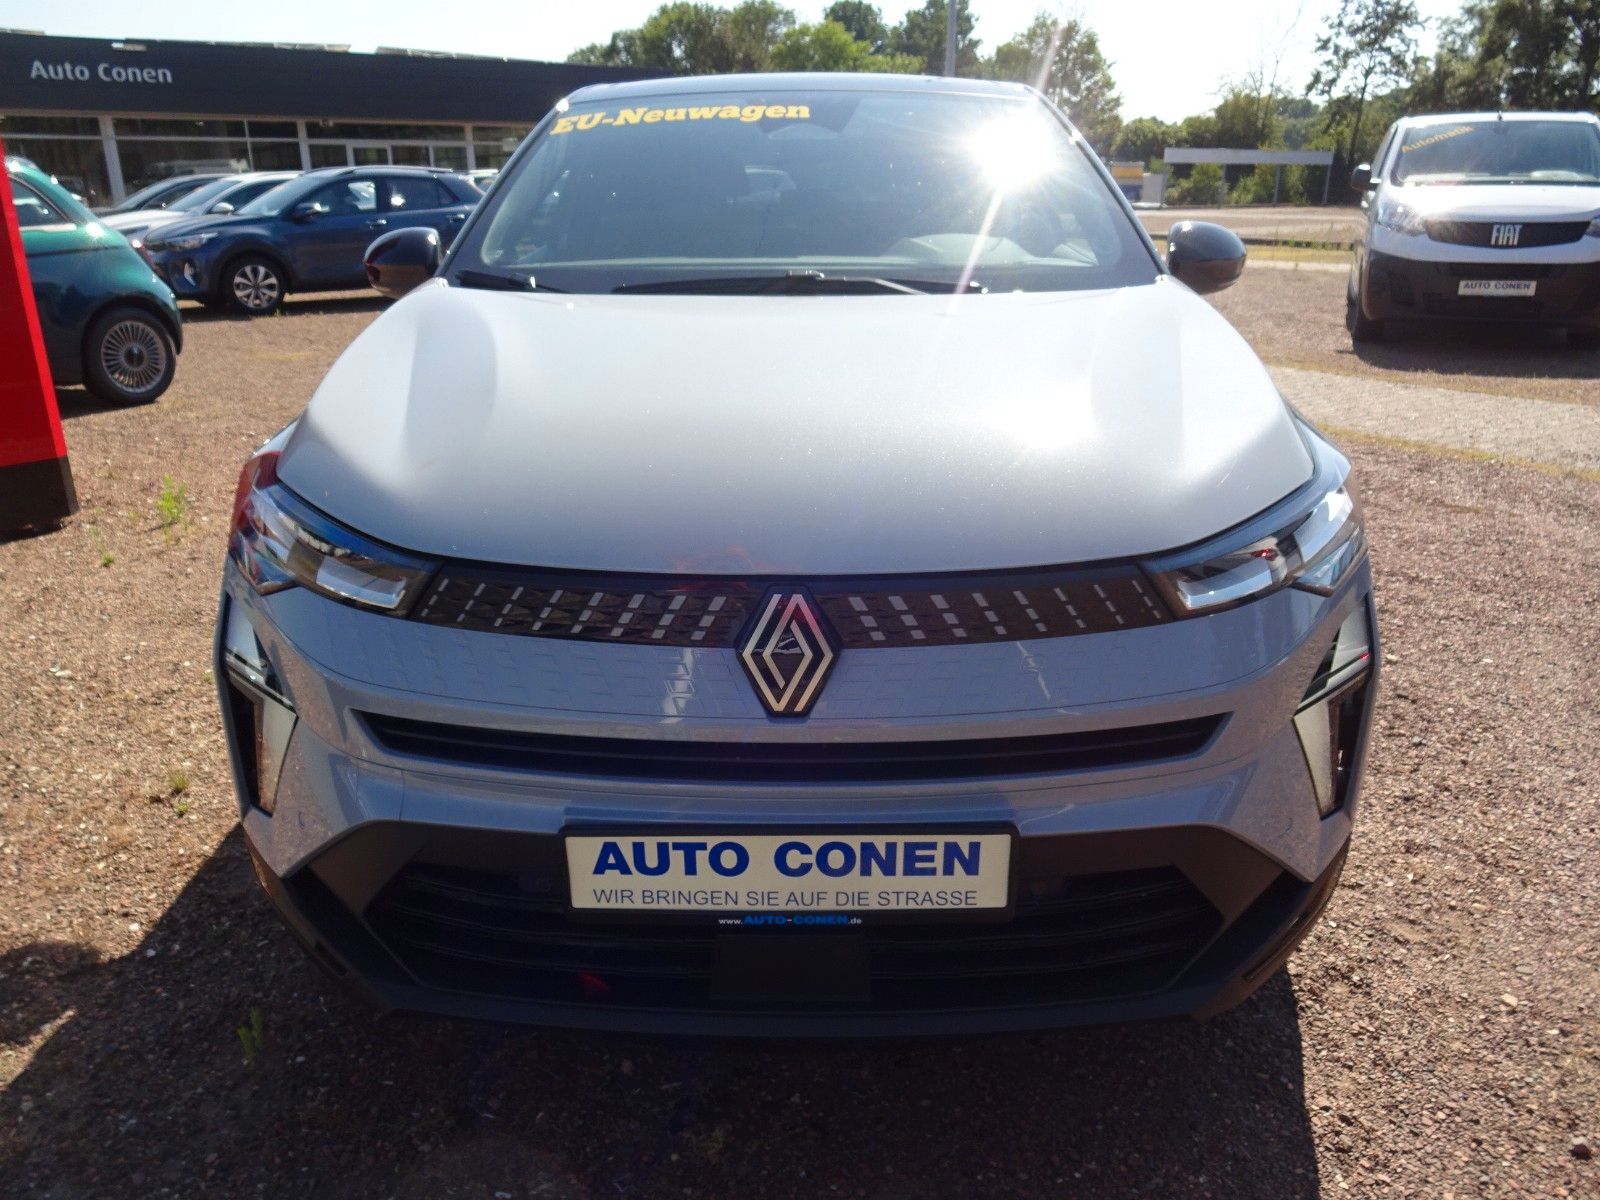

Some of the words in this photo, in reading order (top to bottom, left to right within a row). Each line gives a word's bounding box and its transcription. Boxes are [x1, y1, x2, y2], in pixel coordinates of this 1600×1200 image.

[30, 60, 90, 81] Auto
[97, 62, 173, 84] Conen
[550, 103, 811, 135] EU-Neuwagen
[1401, 125, 1475, 154] Automatik
[1490, 224, 1522, 246] FIAT
[1463, 281, 1491, 289] AUTO
[1494, 281, 1531, 290] CONEN
[592, 841, 750, 877] AUTO
[773, 841, 981, 877] CONEN
[592, 888, 635, 904] WIR
[642, 889, 738, 906] BRINGEN
[746, 890, 780, 907] SIE
[785, 891, 828, 907] AUF
[836, 891, 870, 907] DIE
[877, 890, 978, 907] STRASSE
[718, 914, 862, 926] www.AUTO-CONEN.de
